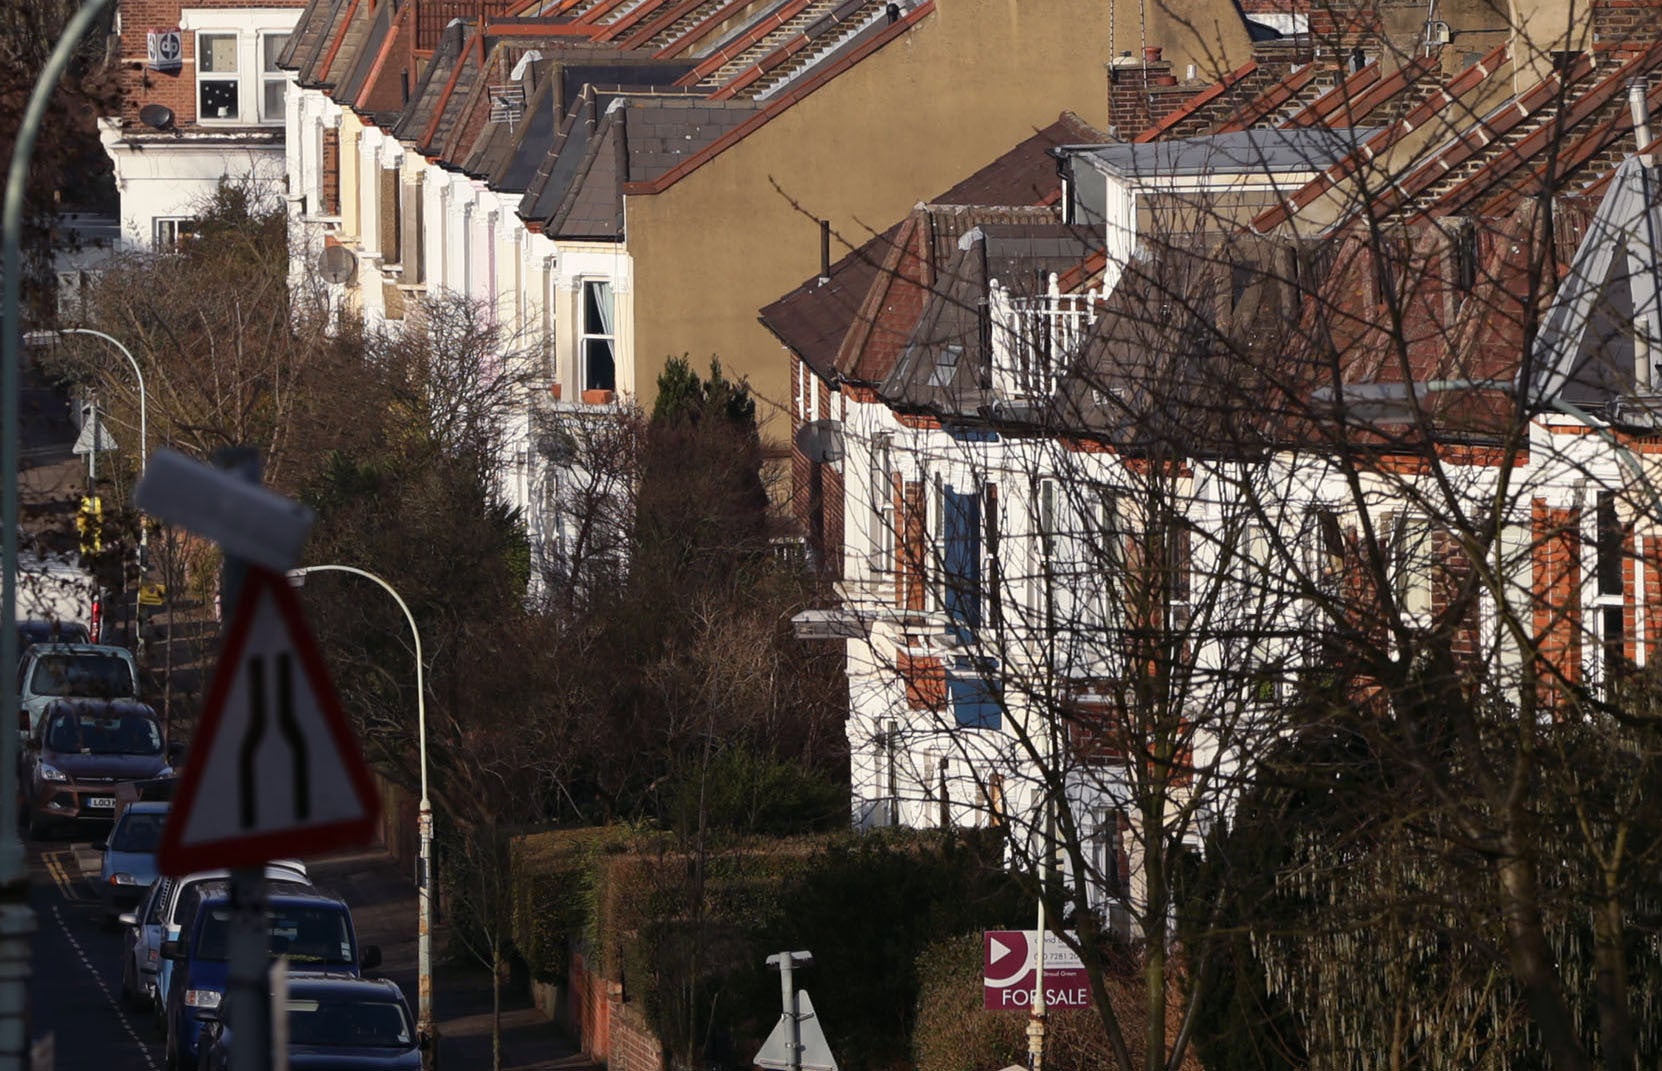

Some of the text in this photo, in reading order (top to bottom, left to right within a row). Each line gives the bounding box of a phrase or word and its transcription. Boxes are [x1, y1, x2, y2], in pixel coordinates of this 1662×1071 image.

[1034, 952, 1048, 960] 00
[1050, 952, 1067, 960] 7281
[1002, 988, 1087, 1006] FOR SALE
